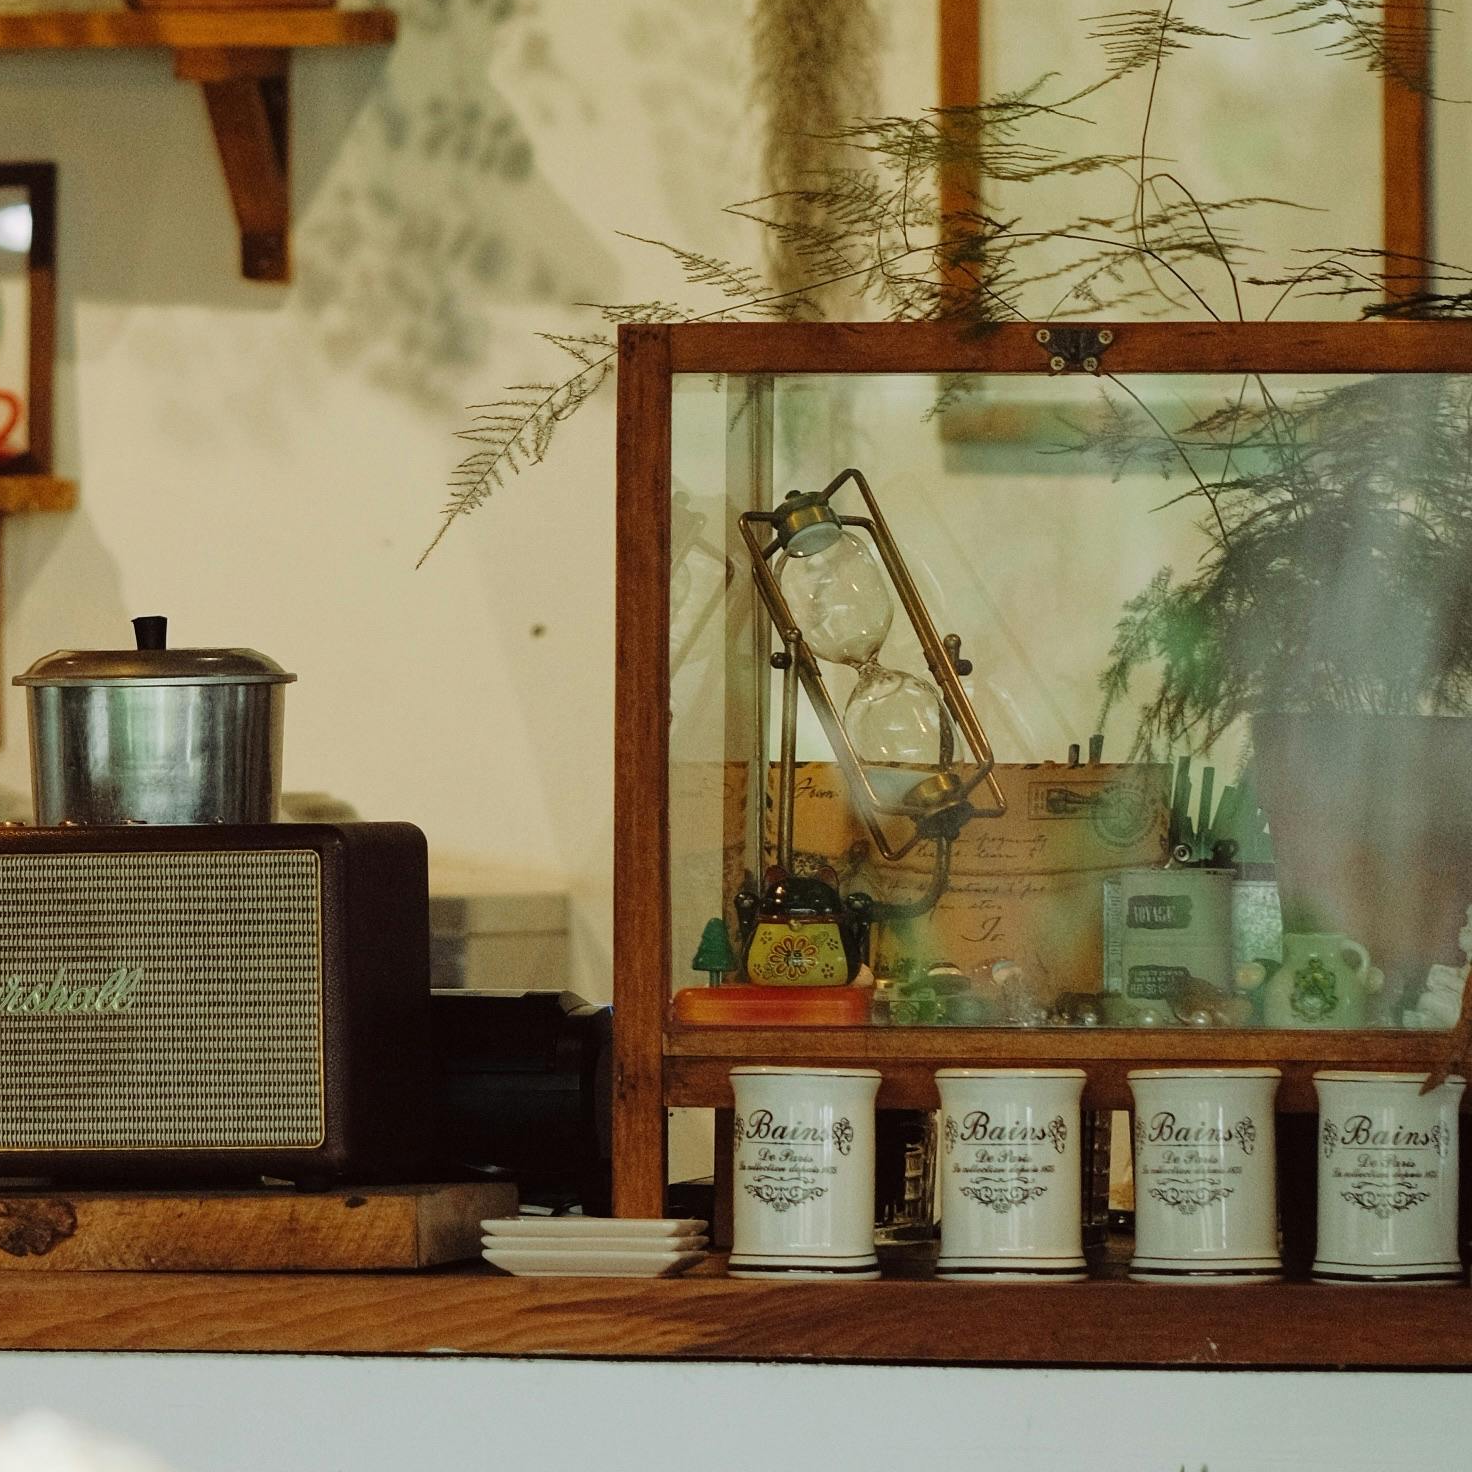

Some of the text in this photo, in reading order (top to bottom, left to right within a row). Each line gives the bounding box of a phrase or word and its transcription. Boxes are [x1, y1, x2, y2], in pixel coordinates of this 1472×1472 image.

[959, 1110, 1047, 1141] Bains
[1148, 1111, 1233, 1143] Bains
[1340, 1114, 1430, 1146] Bains
[758, 1147, 814, 1163] De Paris
[975, 1148, 994, 1163] De
